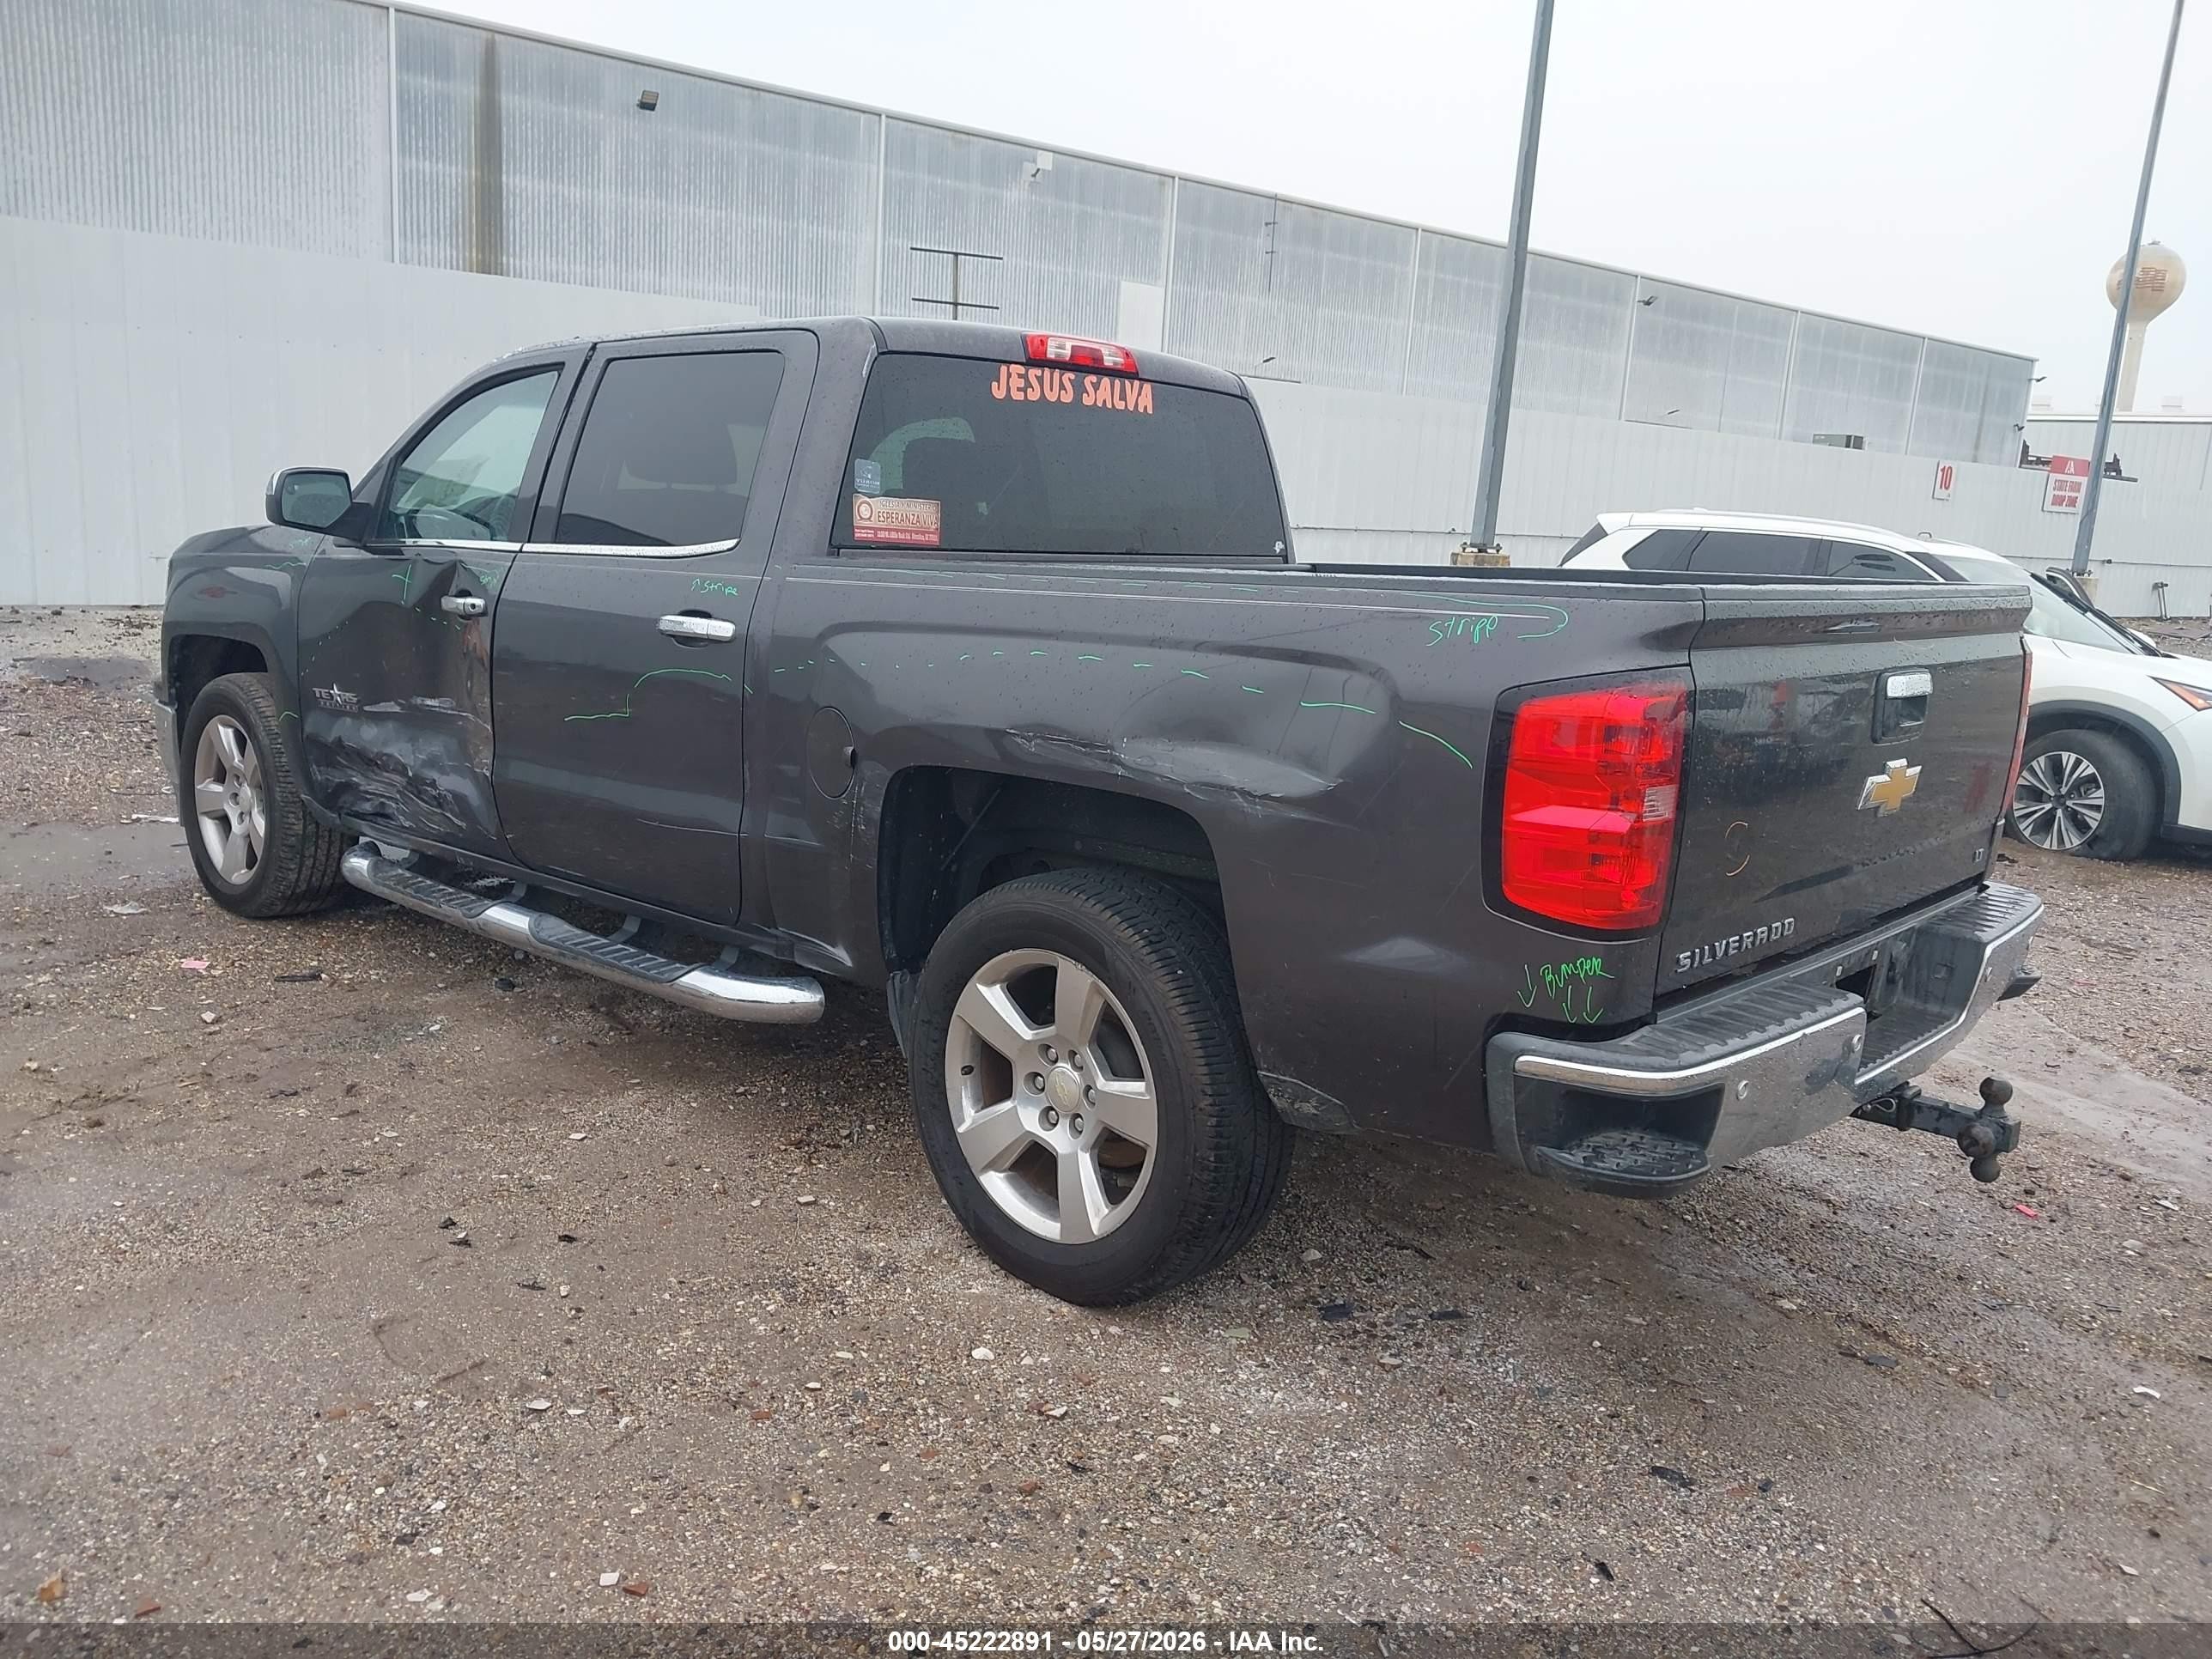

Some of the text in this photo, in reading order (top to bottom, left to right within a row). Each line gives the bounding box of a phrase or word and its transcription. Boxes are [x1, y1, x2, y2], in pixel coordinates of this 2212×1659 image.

[991, 364, 1153, 415] JESUS SALVA
[1939, 465, 1953, 490] 10
[877, 511, 939, 527] ESPERANZA VIVA
[1675, 917, 1796, 974] SILVERADO
